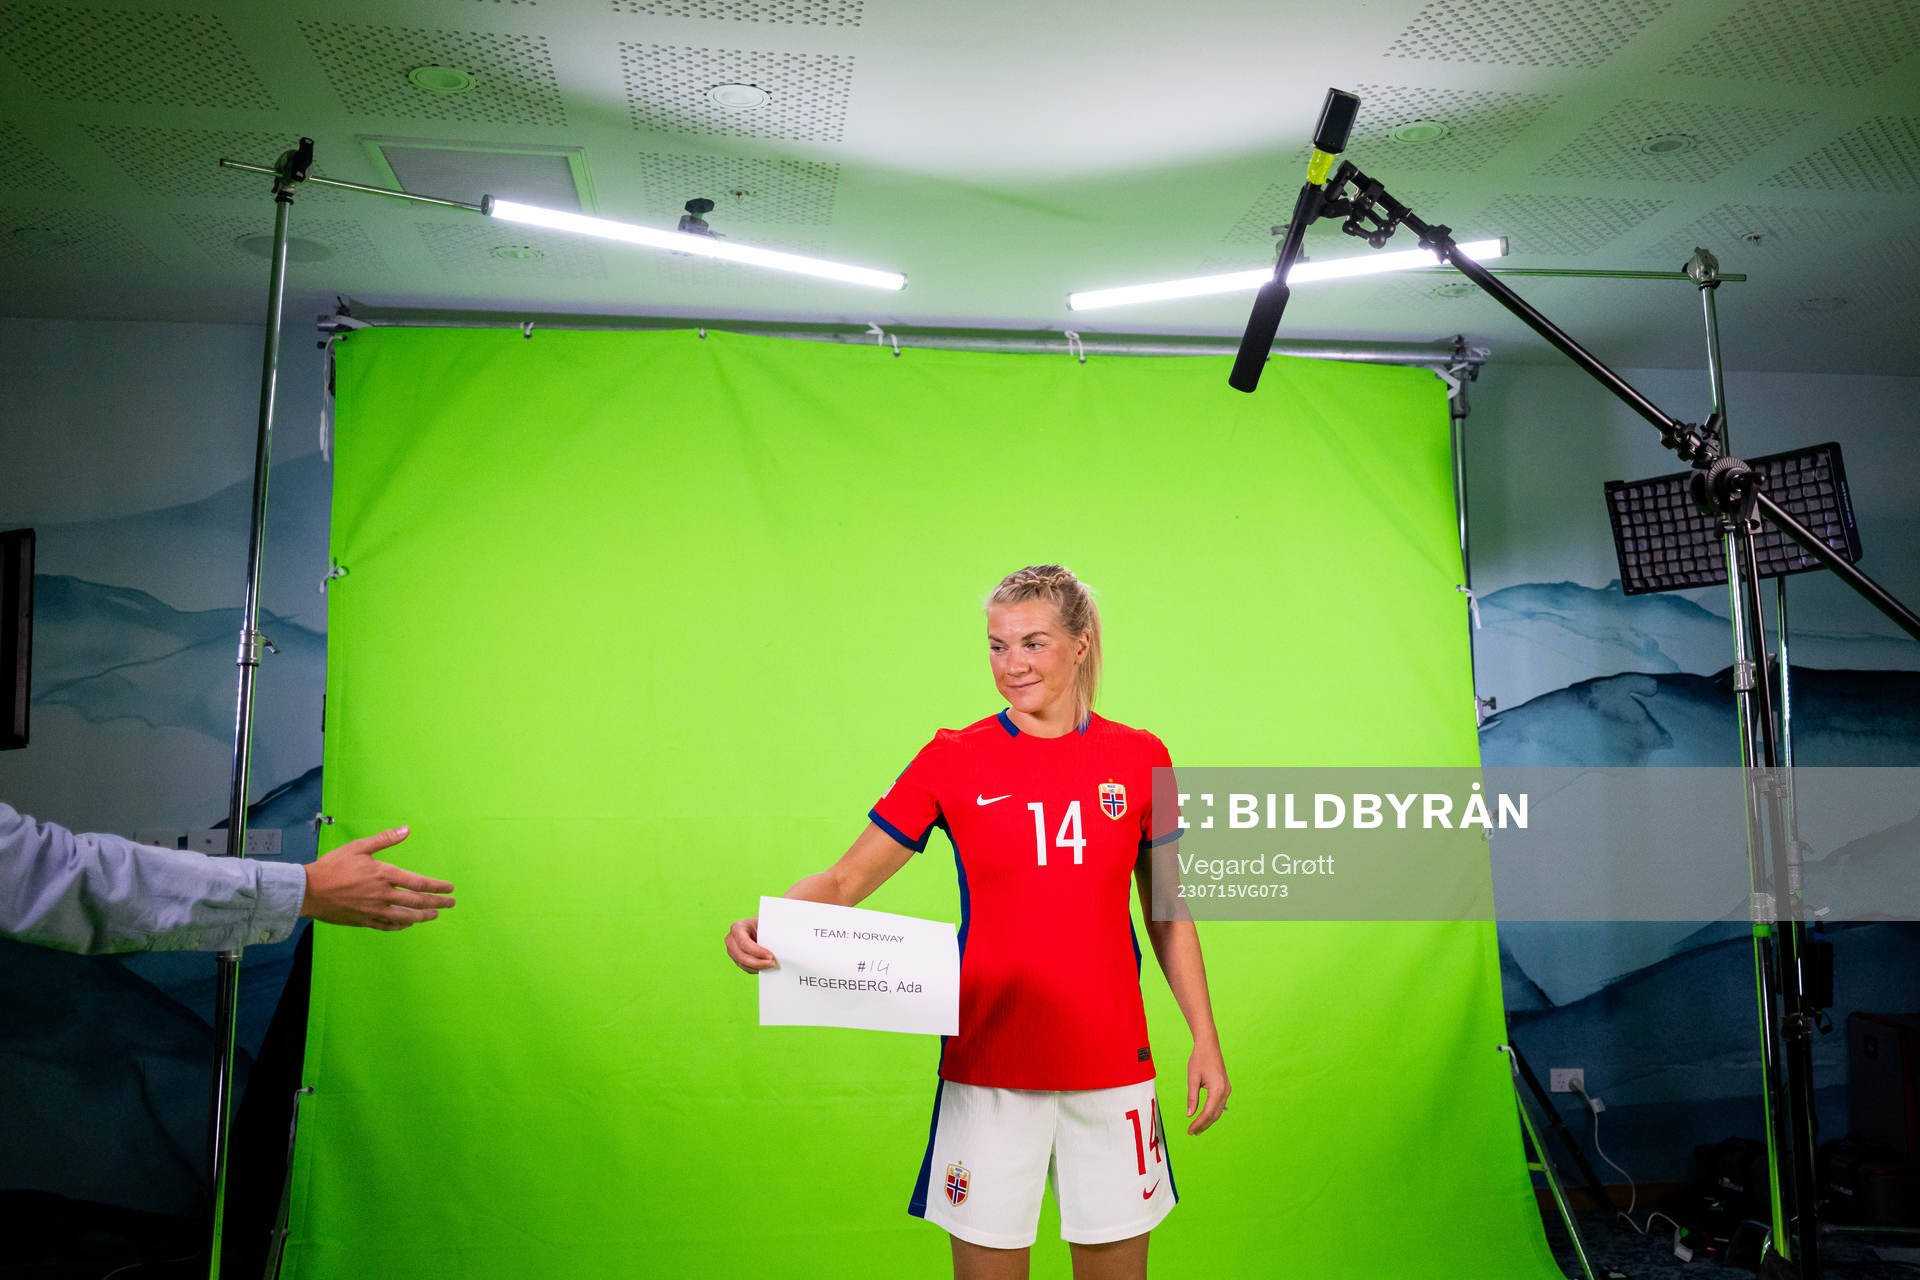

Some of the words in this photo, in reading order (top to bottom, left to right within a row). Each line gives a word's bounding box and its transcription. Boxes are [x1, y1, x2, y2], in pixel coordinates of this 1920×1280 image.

[1027, 800, 1087, 866] 14
[813, 928, 849, 939] TEAM:
[853, 932, 904, 943] NORWAY
[799, 975, 892, 993] HEGERBERG,
[896, 981, 922, 993] Ada
[1125, 1098, 1162, 1176] 14
